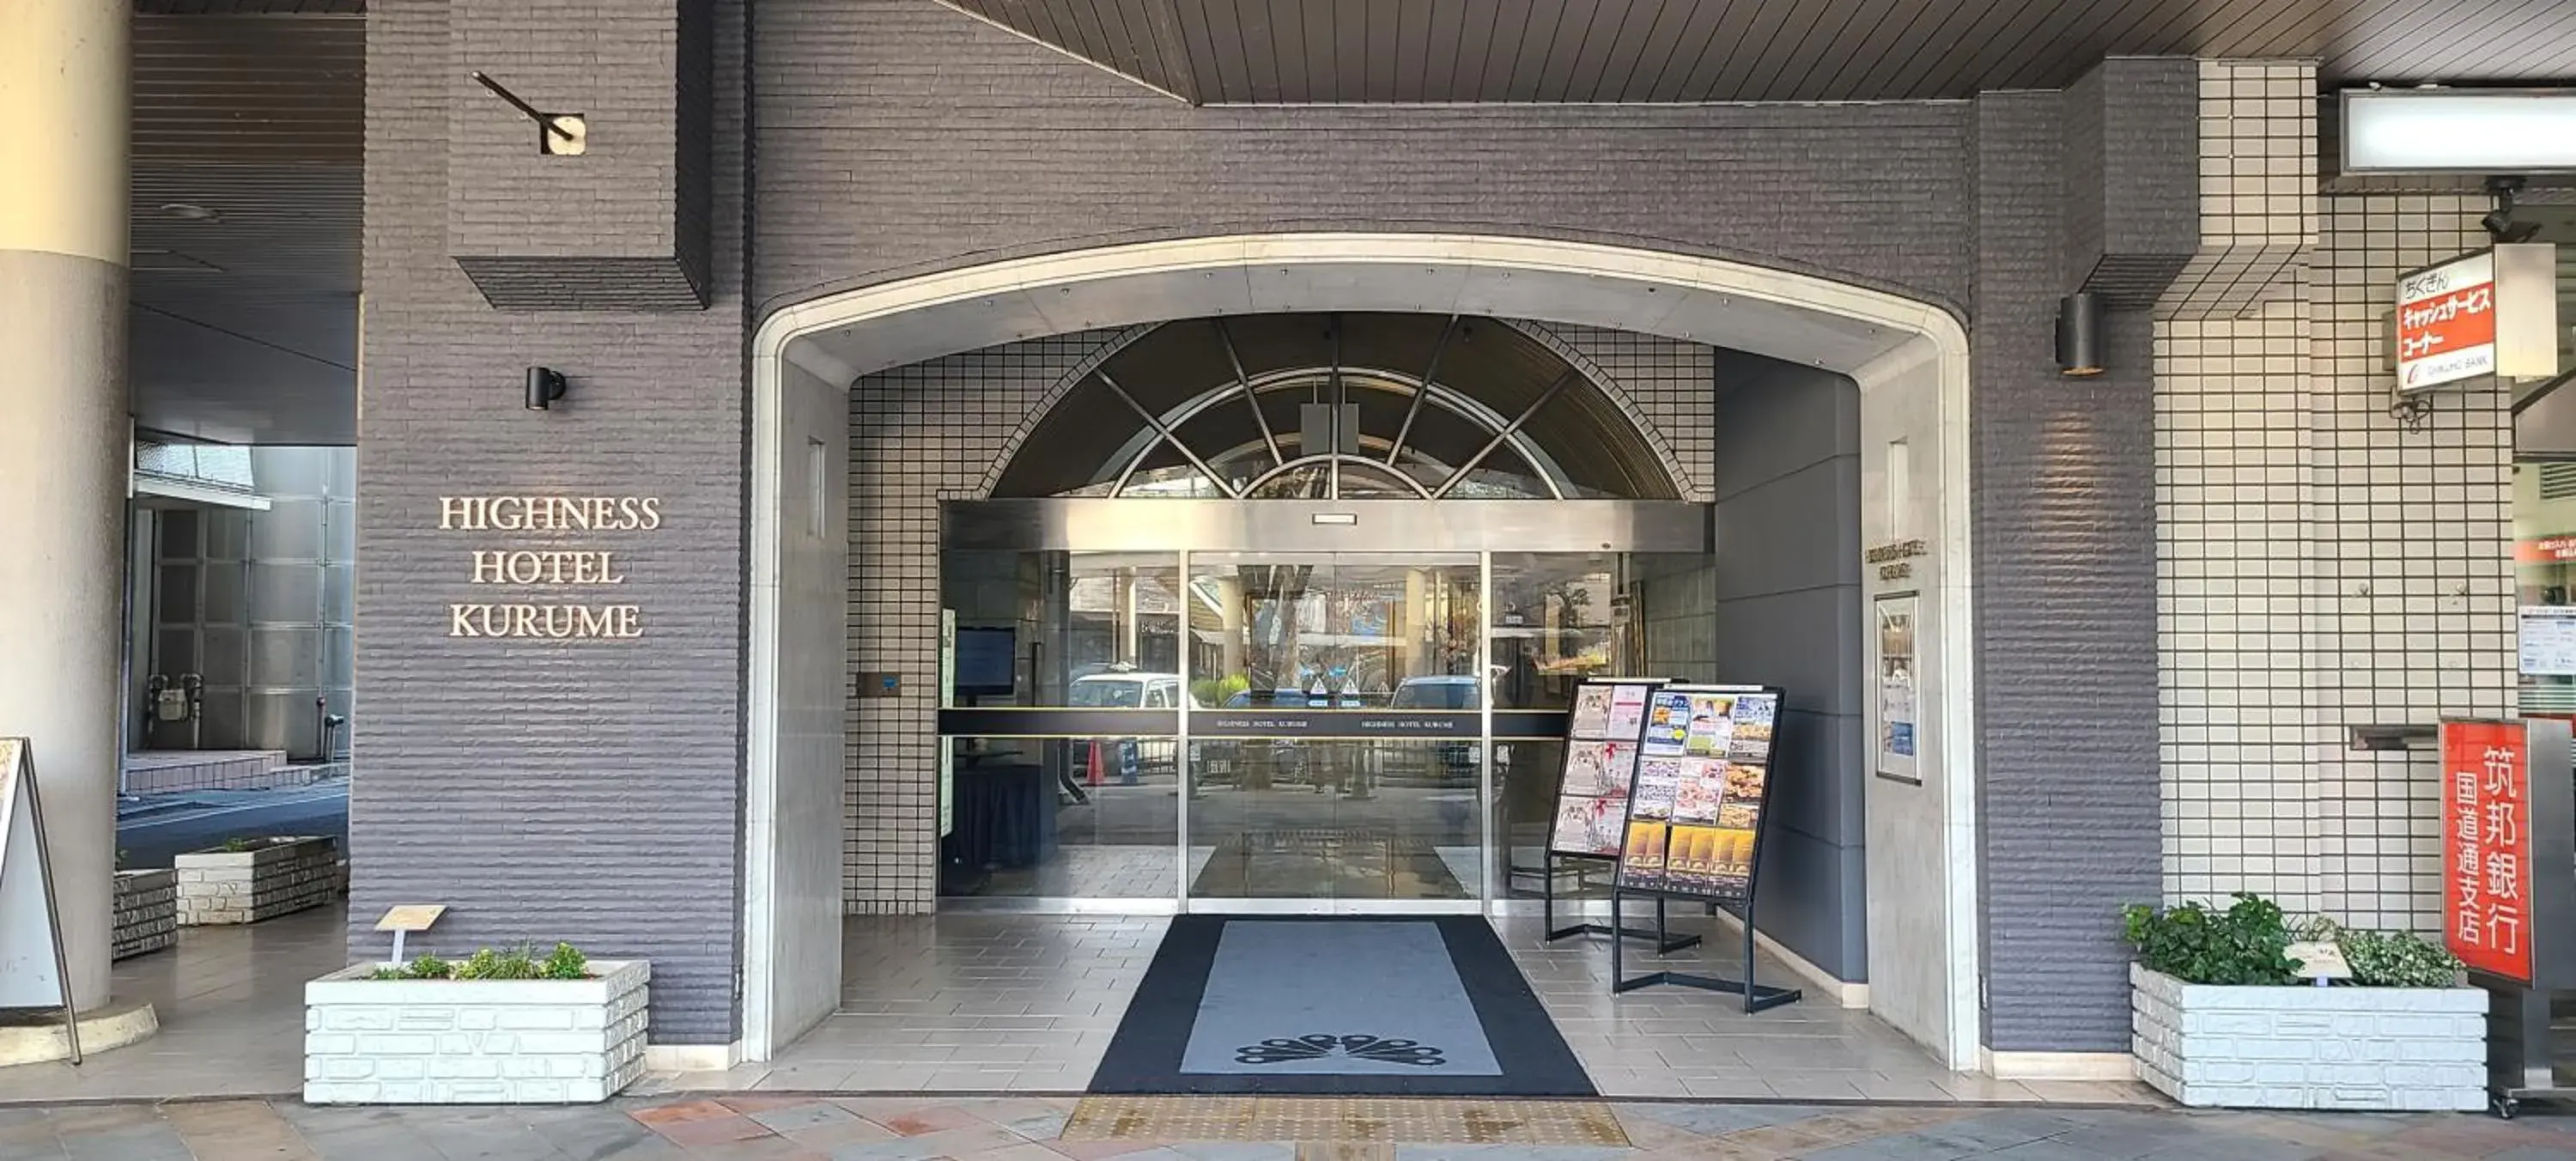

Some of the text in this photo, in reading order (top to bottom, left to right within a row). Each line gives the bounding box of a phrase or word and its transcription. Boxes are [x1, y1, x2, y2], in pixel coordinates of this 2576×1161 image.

[2406, 270, 2448, 299] ちくぎん
[2403, 288, 2491, 330] キャッシュサービス
[2403, 330, 2445, 357] コーナー
[439, 496, 661, 531] HIGHNESS
[471, 550, 624, 585] HOTEL
[448, 604, 644, 638] KURUME
[2456, 771, 2481, 946] 国道通支店
[2482, 746, 2519, 956] 筑邦銀行
